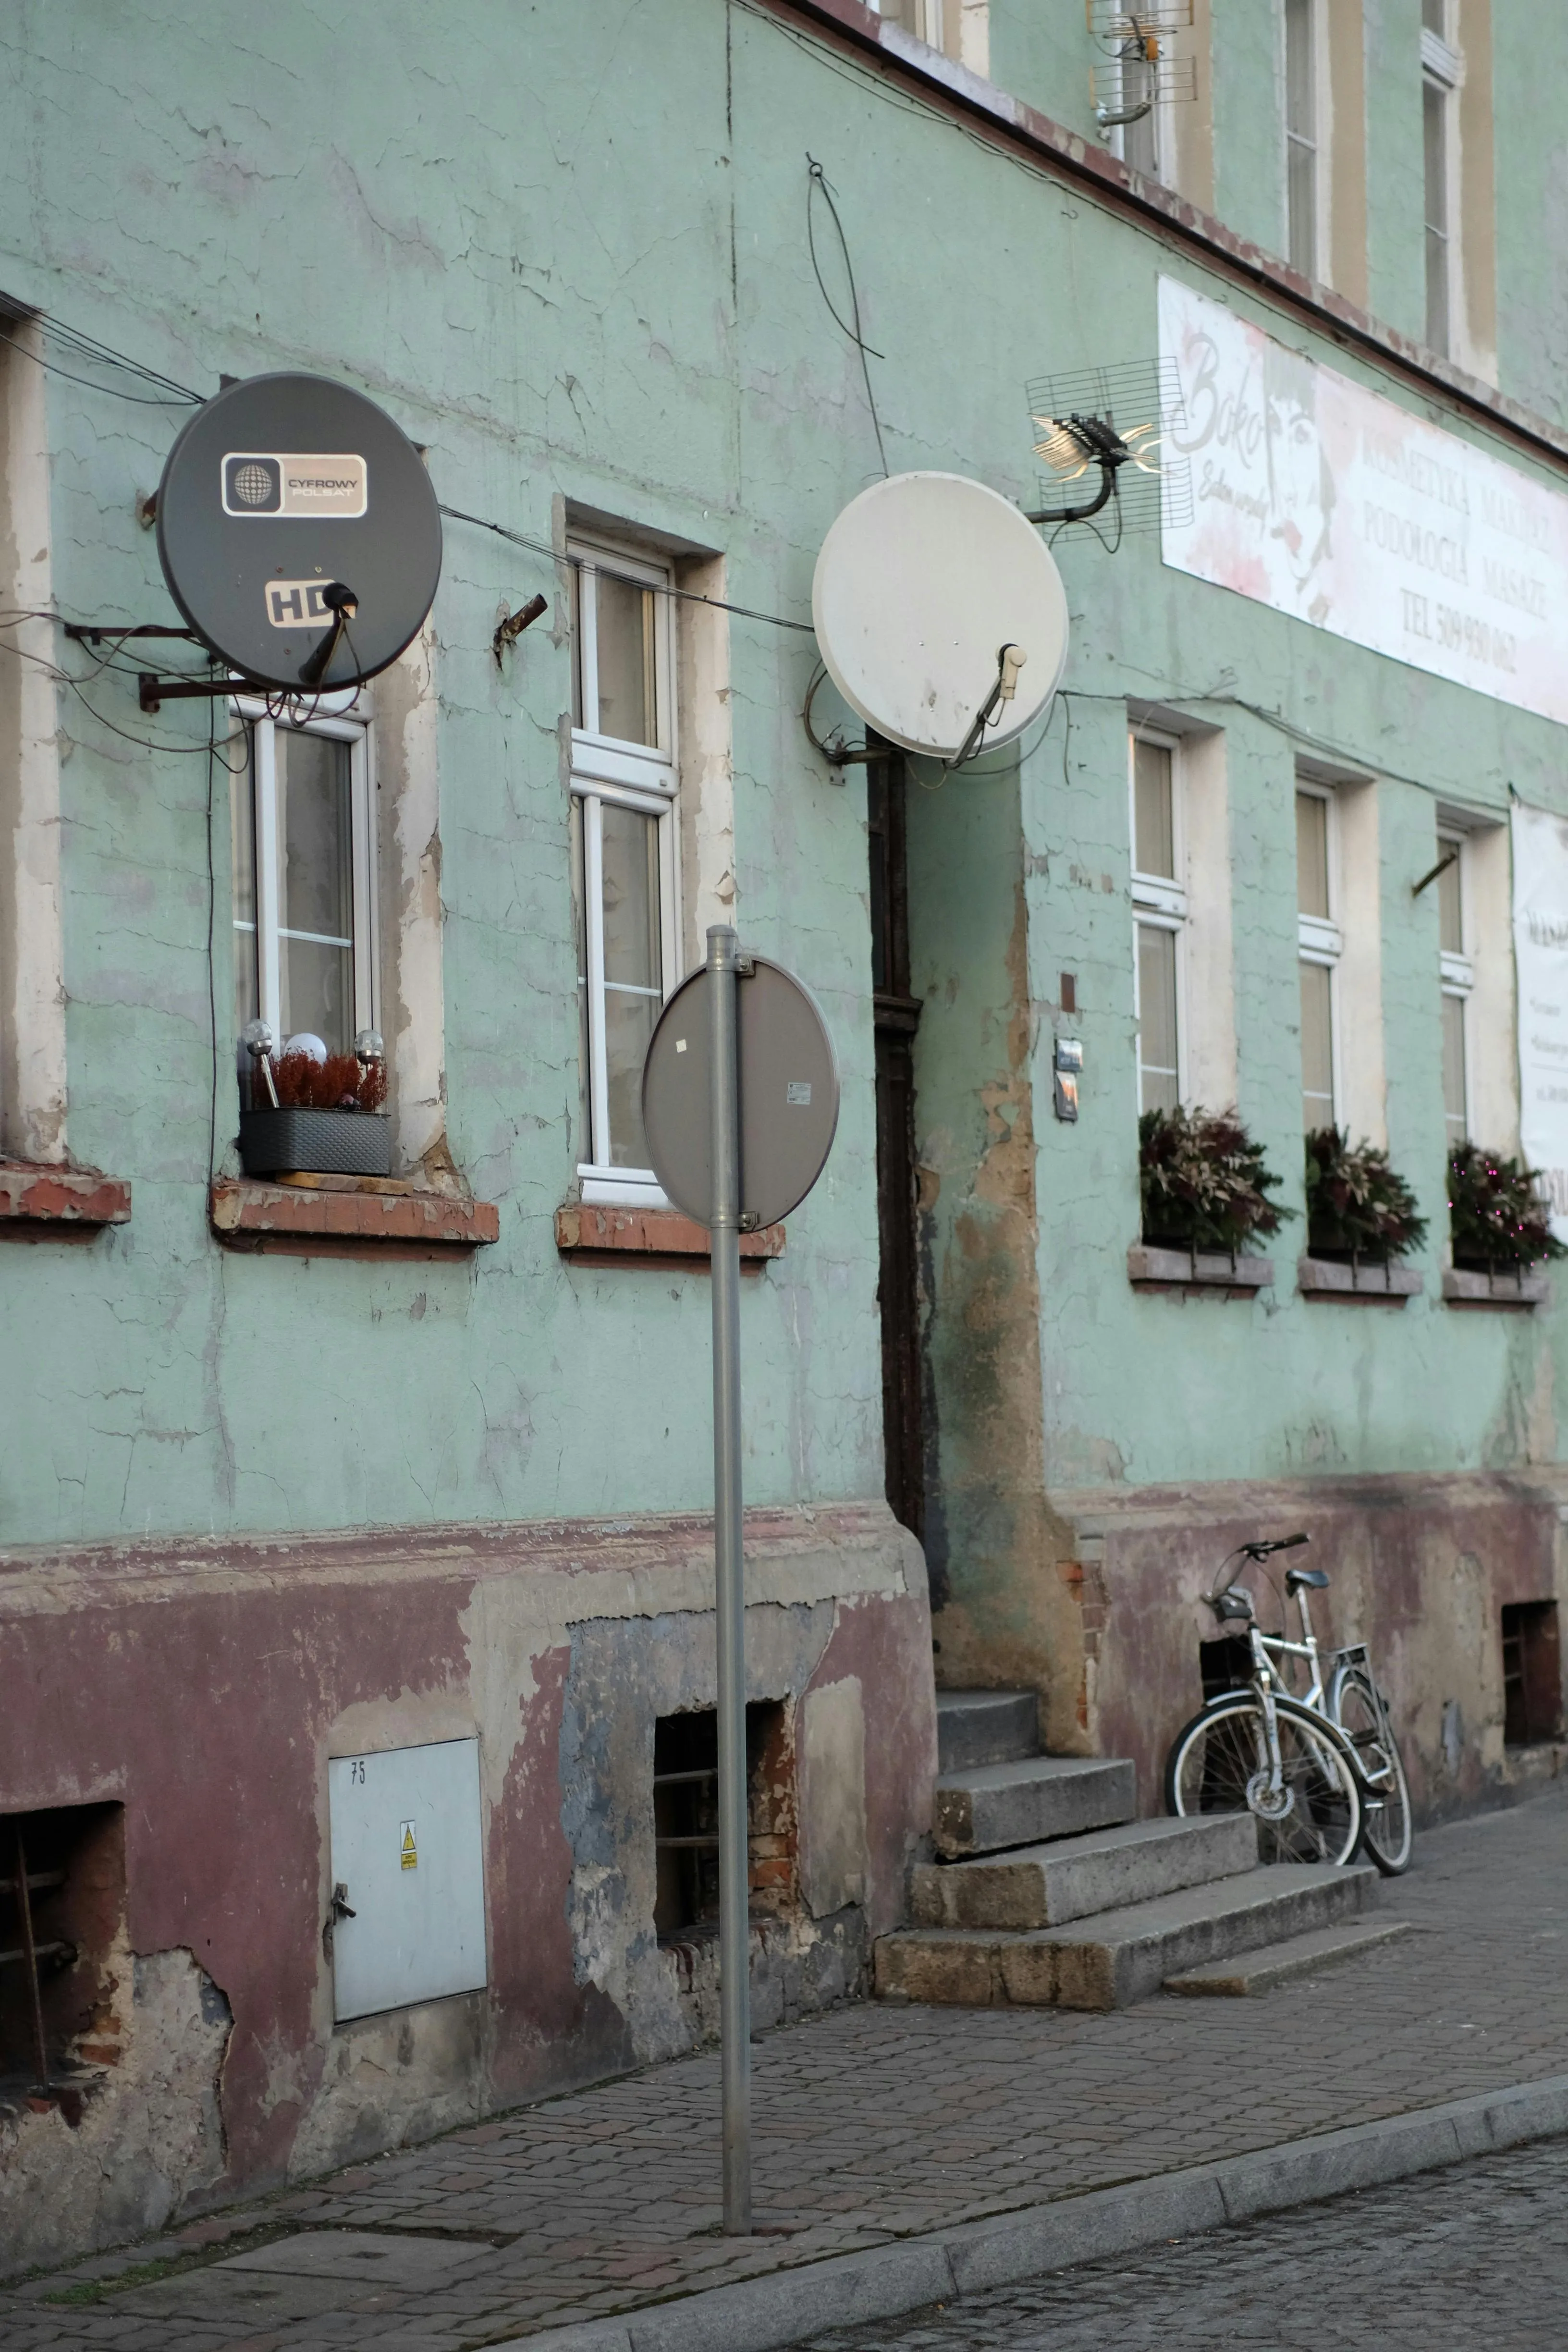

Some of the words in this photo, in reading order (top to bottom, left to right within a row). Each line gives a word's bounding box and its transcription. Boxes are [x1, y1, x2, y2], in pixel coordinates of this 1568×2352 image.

[288, 479, 358, 488] CYFROWY
[293, 489, 354, 497] POLSAT
[1362, 500, 1470, 587] PODOLOGIA
[270, 585, 334, 623] HD
[351, 1761, 365, 1785] 75
